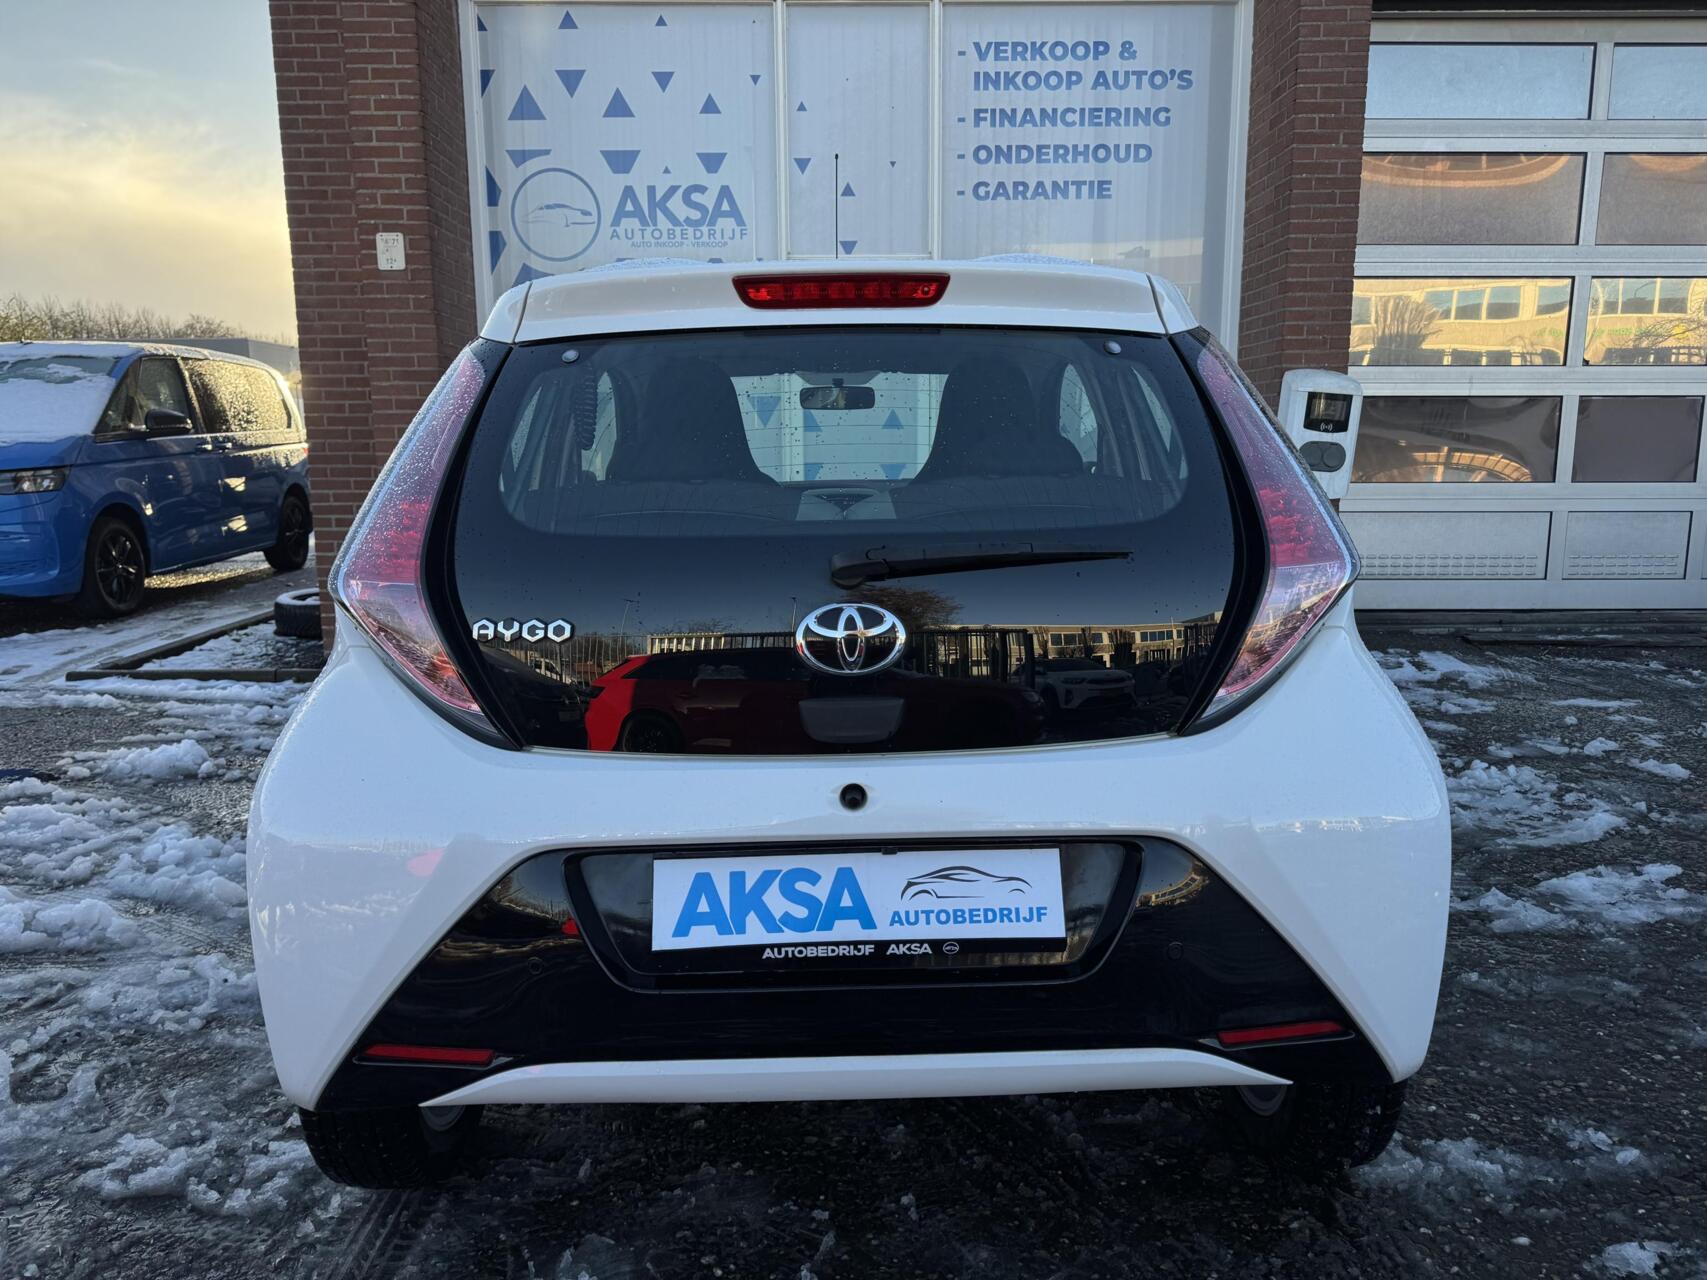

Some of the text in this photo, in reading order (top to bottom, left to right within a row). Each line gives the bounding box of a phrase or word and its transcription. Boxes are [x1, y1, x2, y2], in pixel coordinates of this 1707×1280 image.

[973, 41, 1110, 61] VERKOOP
[1118, 40, 1138, 61] &
[973, 69, 1193, 91] INKOOP AUTO'S
[973, 106, 1171, 128] FINANCIERING
[972, 143, 1152, 165] ONDERHOUD
[971, 180, 1112, 201] GARANTIE
[610, 184, 747, 228] AKSA
[609, 228, 748, 241] AUTOBEDRIJF
[472, 618, 572, 643] AYGO
[672, 866, 878, 938] AKSA
[889, 906, 1048, 927] AUTOBEDRIJF
[762, 943, 933, 959] AUTOBEDRIJF AKSA
